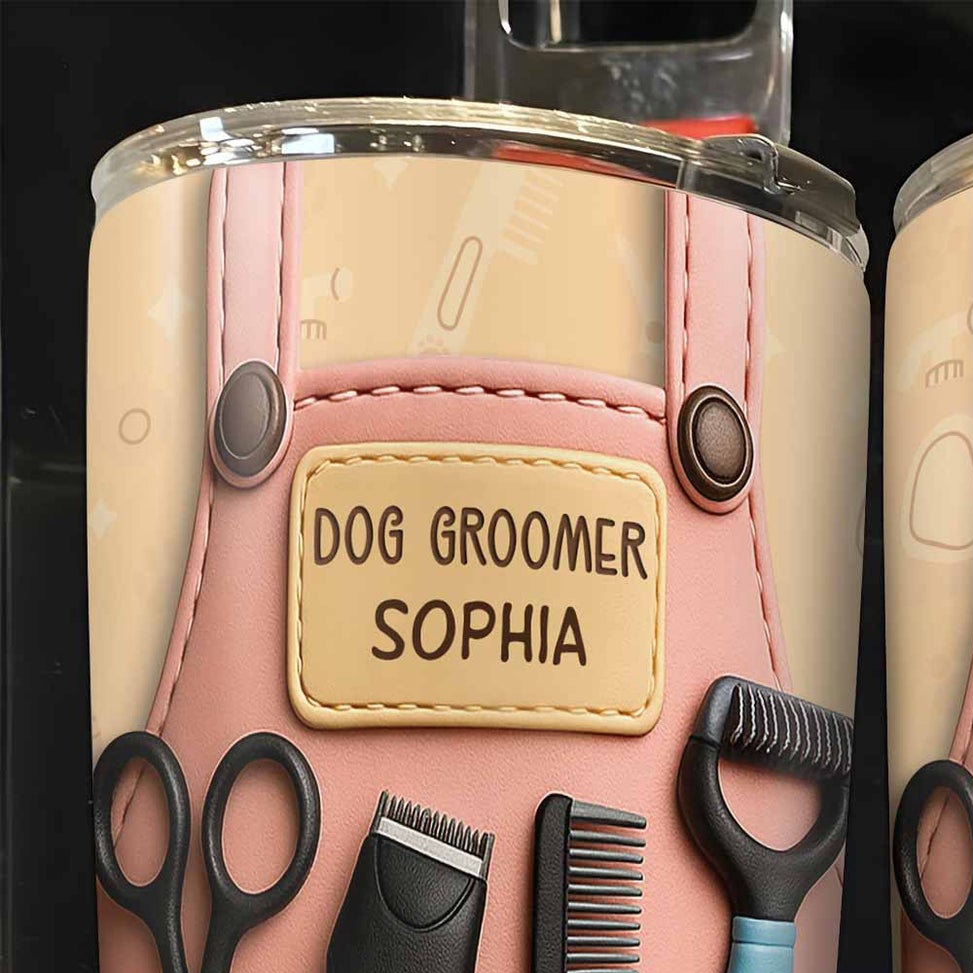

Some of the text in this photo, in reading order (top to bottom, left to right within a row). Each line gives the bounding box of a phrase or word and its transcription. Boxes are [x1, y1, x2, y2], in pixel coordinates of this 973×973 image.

[313, 504, 648, 580] DOG GROOMER
[371, 598, 587, 667] SOPHIA
